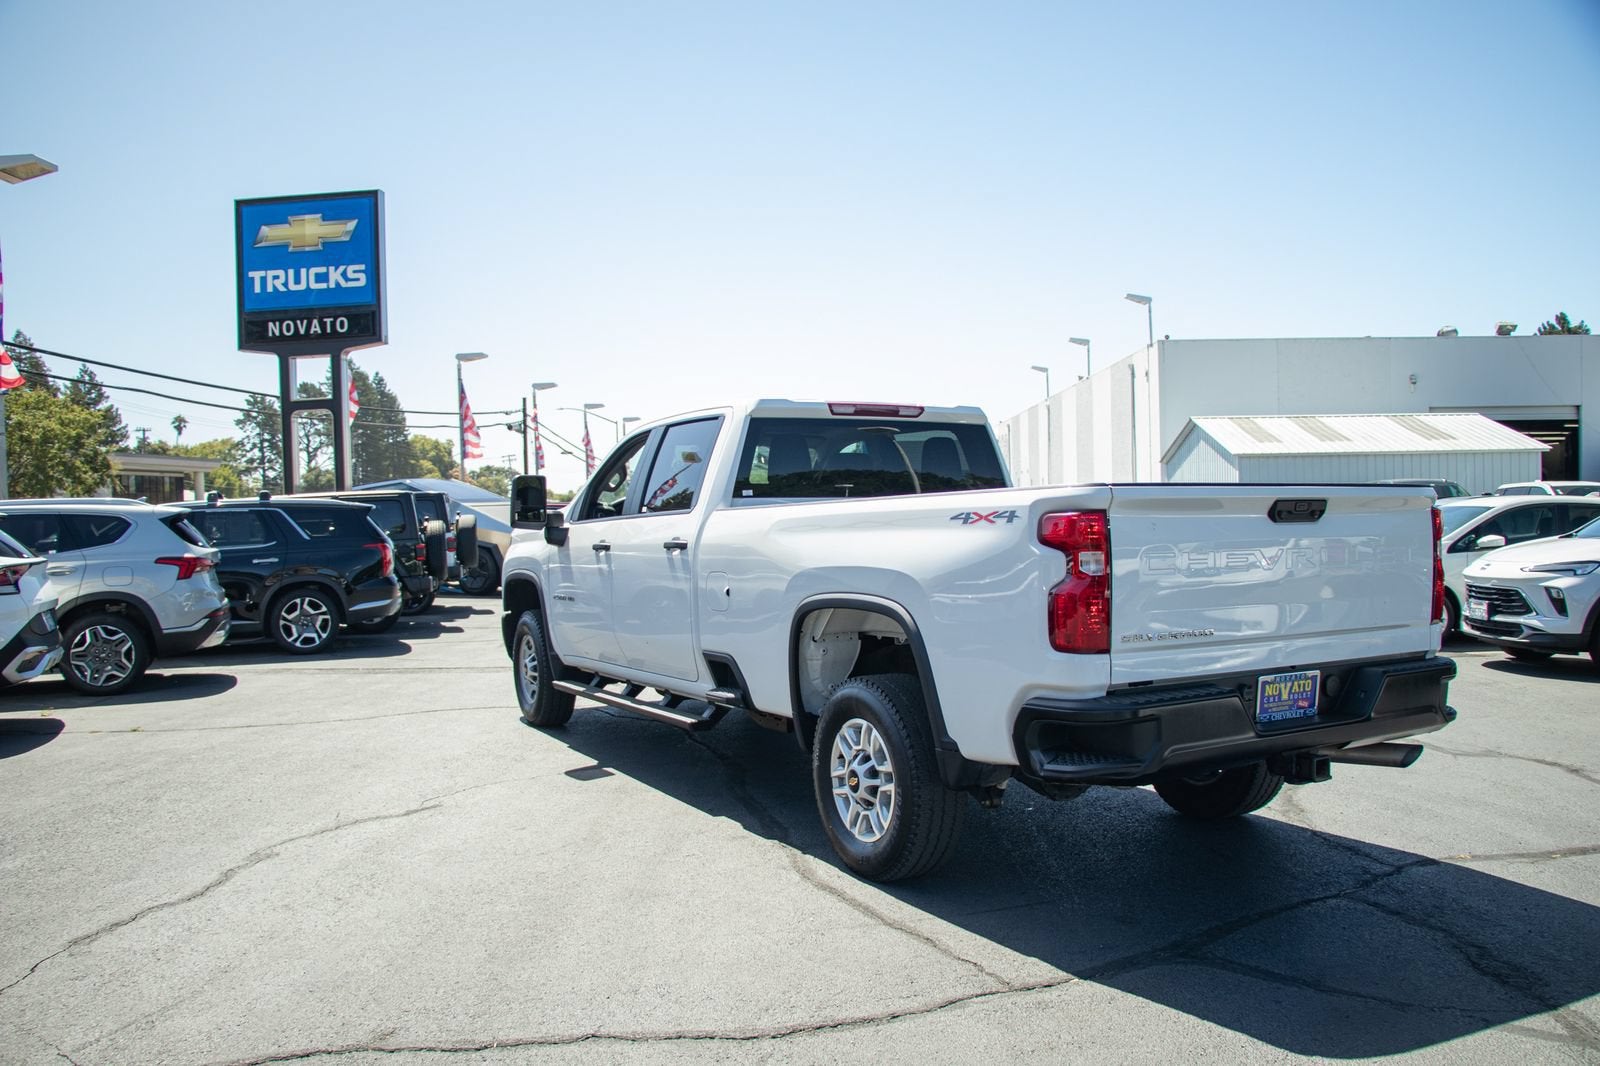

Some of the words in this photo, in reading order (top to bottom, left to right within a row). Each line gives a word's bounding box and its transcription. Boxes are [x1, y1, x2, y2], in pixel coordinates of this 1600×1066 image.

[248, 264, 367, 293] TRUCKS
[268, 316, 349, 337] NOVATO
[1141, 545, 1413, 576] CHEVRO
[1265, 680, 1312, 700] NOVATO
[1271, 709, 1304, 721] CHEVROLET
